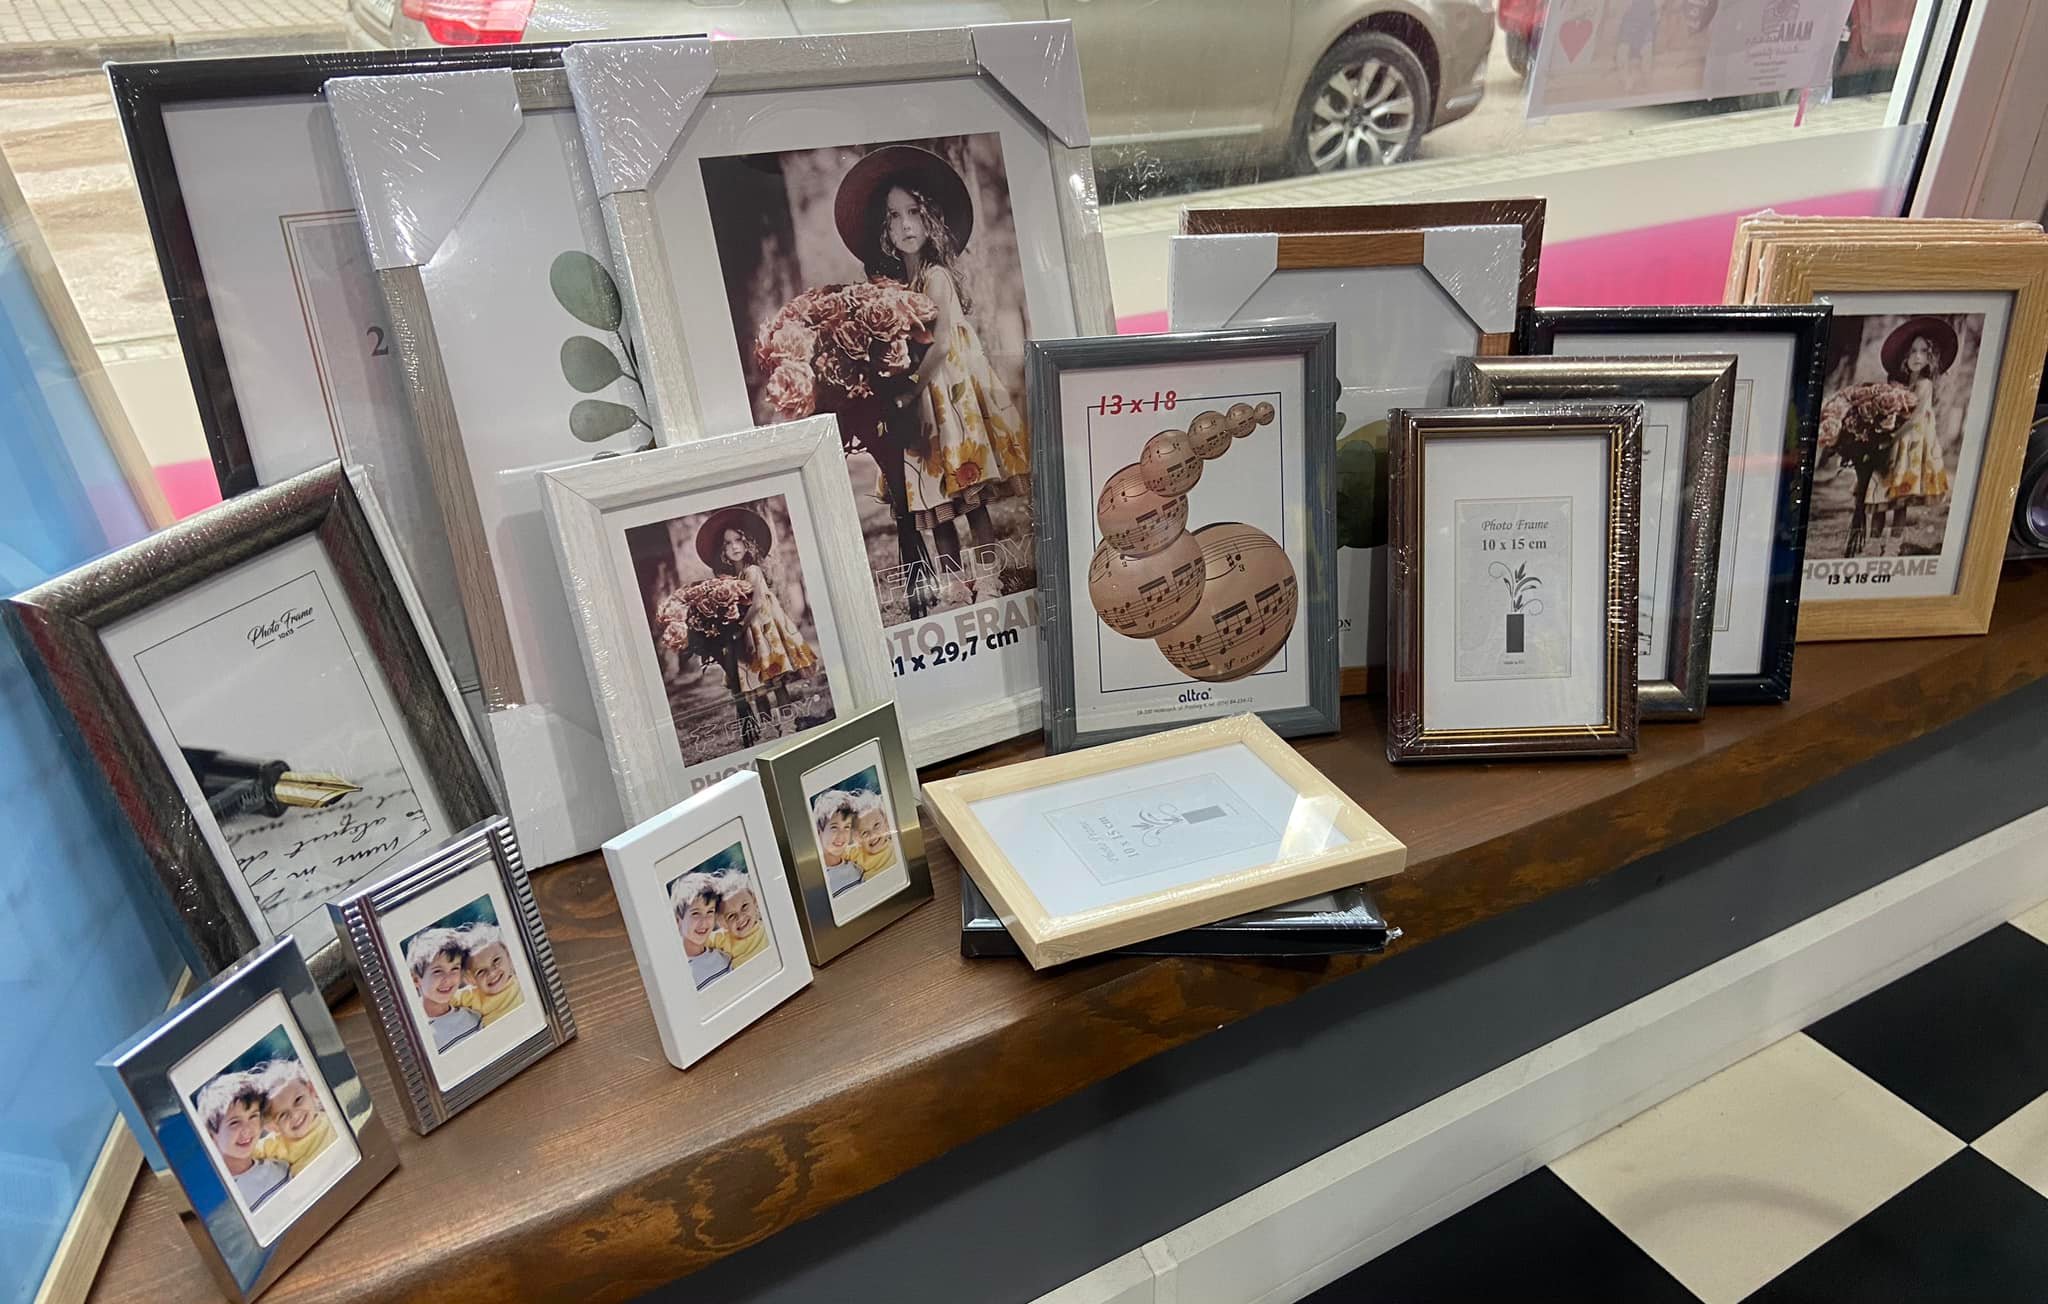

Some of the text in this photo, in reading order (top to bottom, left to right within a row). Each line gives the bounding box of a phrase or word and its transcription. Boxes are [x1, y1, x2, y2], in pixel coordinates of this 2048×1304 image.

[1099, 390, 1177, 416] 13 x 18
[1481, 518, 1549, 531] Photo Frame
[1482, 538, 1547, 551] 10 x 15 cm
[875, 533, 1034, 604] FANDY
[1827, 573, 1891, 585] 13 x 18 cm
[1866, 559, 1939, 578] FRAME
[247, 607, 313, 647] Photo Frame
[891, 628, 1019, 678] 1 x 29,7 cm
[1178, 689, 1210, 703] altra
[725, 696, 813, 741] FANDY
